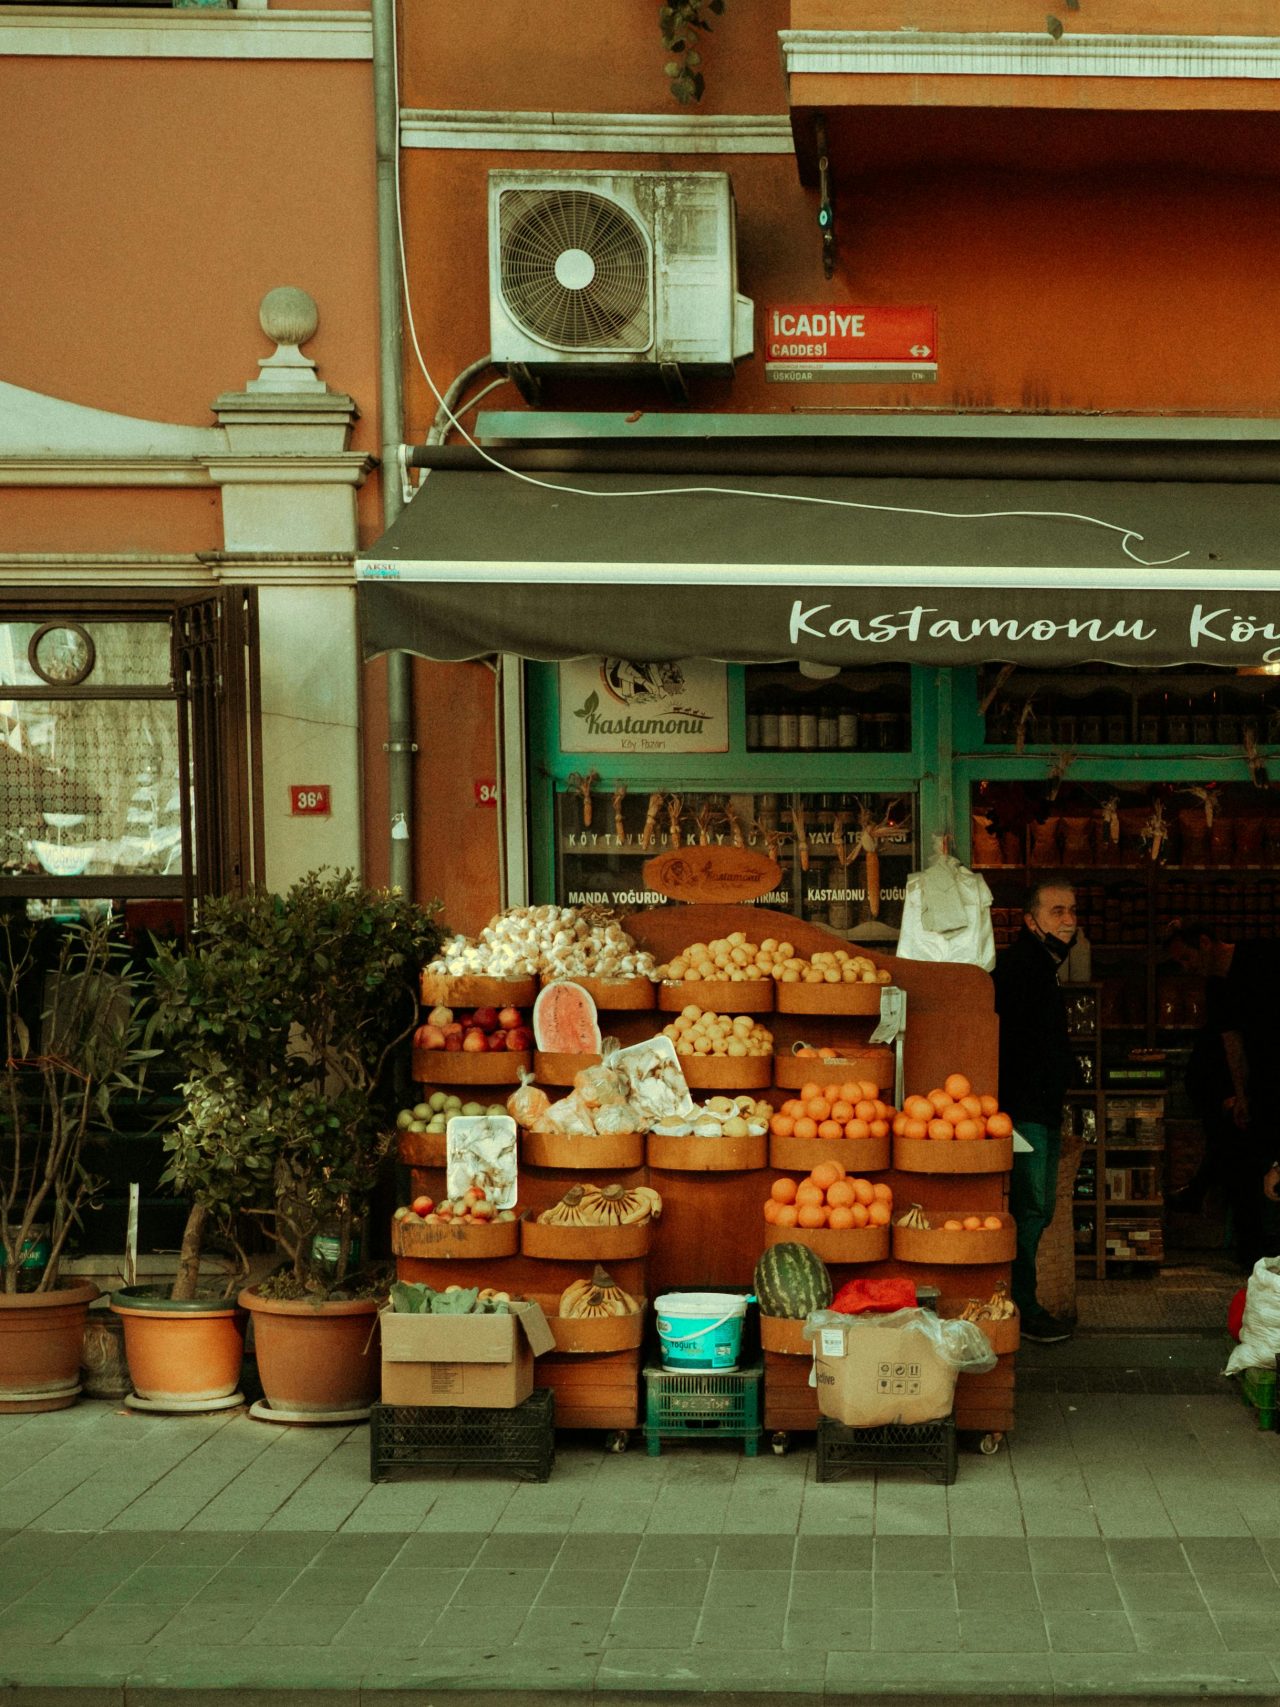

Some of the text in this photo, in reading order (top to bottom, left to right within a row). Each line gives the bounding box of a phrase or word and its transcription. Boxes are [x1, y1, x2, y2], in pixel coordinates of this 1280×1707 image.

[773, 310, 865, 337] İCADİYE
[771, 342, 827, 356] CADDESİ
[772, 370, 813, 381] ÜSKÜDAR
[788, 598, 1157, 644] Kastamonu
[586, 713, 704, 735] Kastamonu
[621, 739, 637, 751] Köy
[569, 831, 598, 846] KÖY
[808, 832, 845, 844] YAYL
[568, 889, 668, 904] MANDA YOĞURDU
[807, 886, 907, 902] KASTAMONU CUĞU
